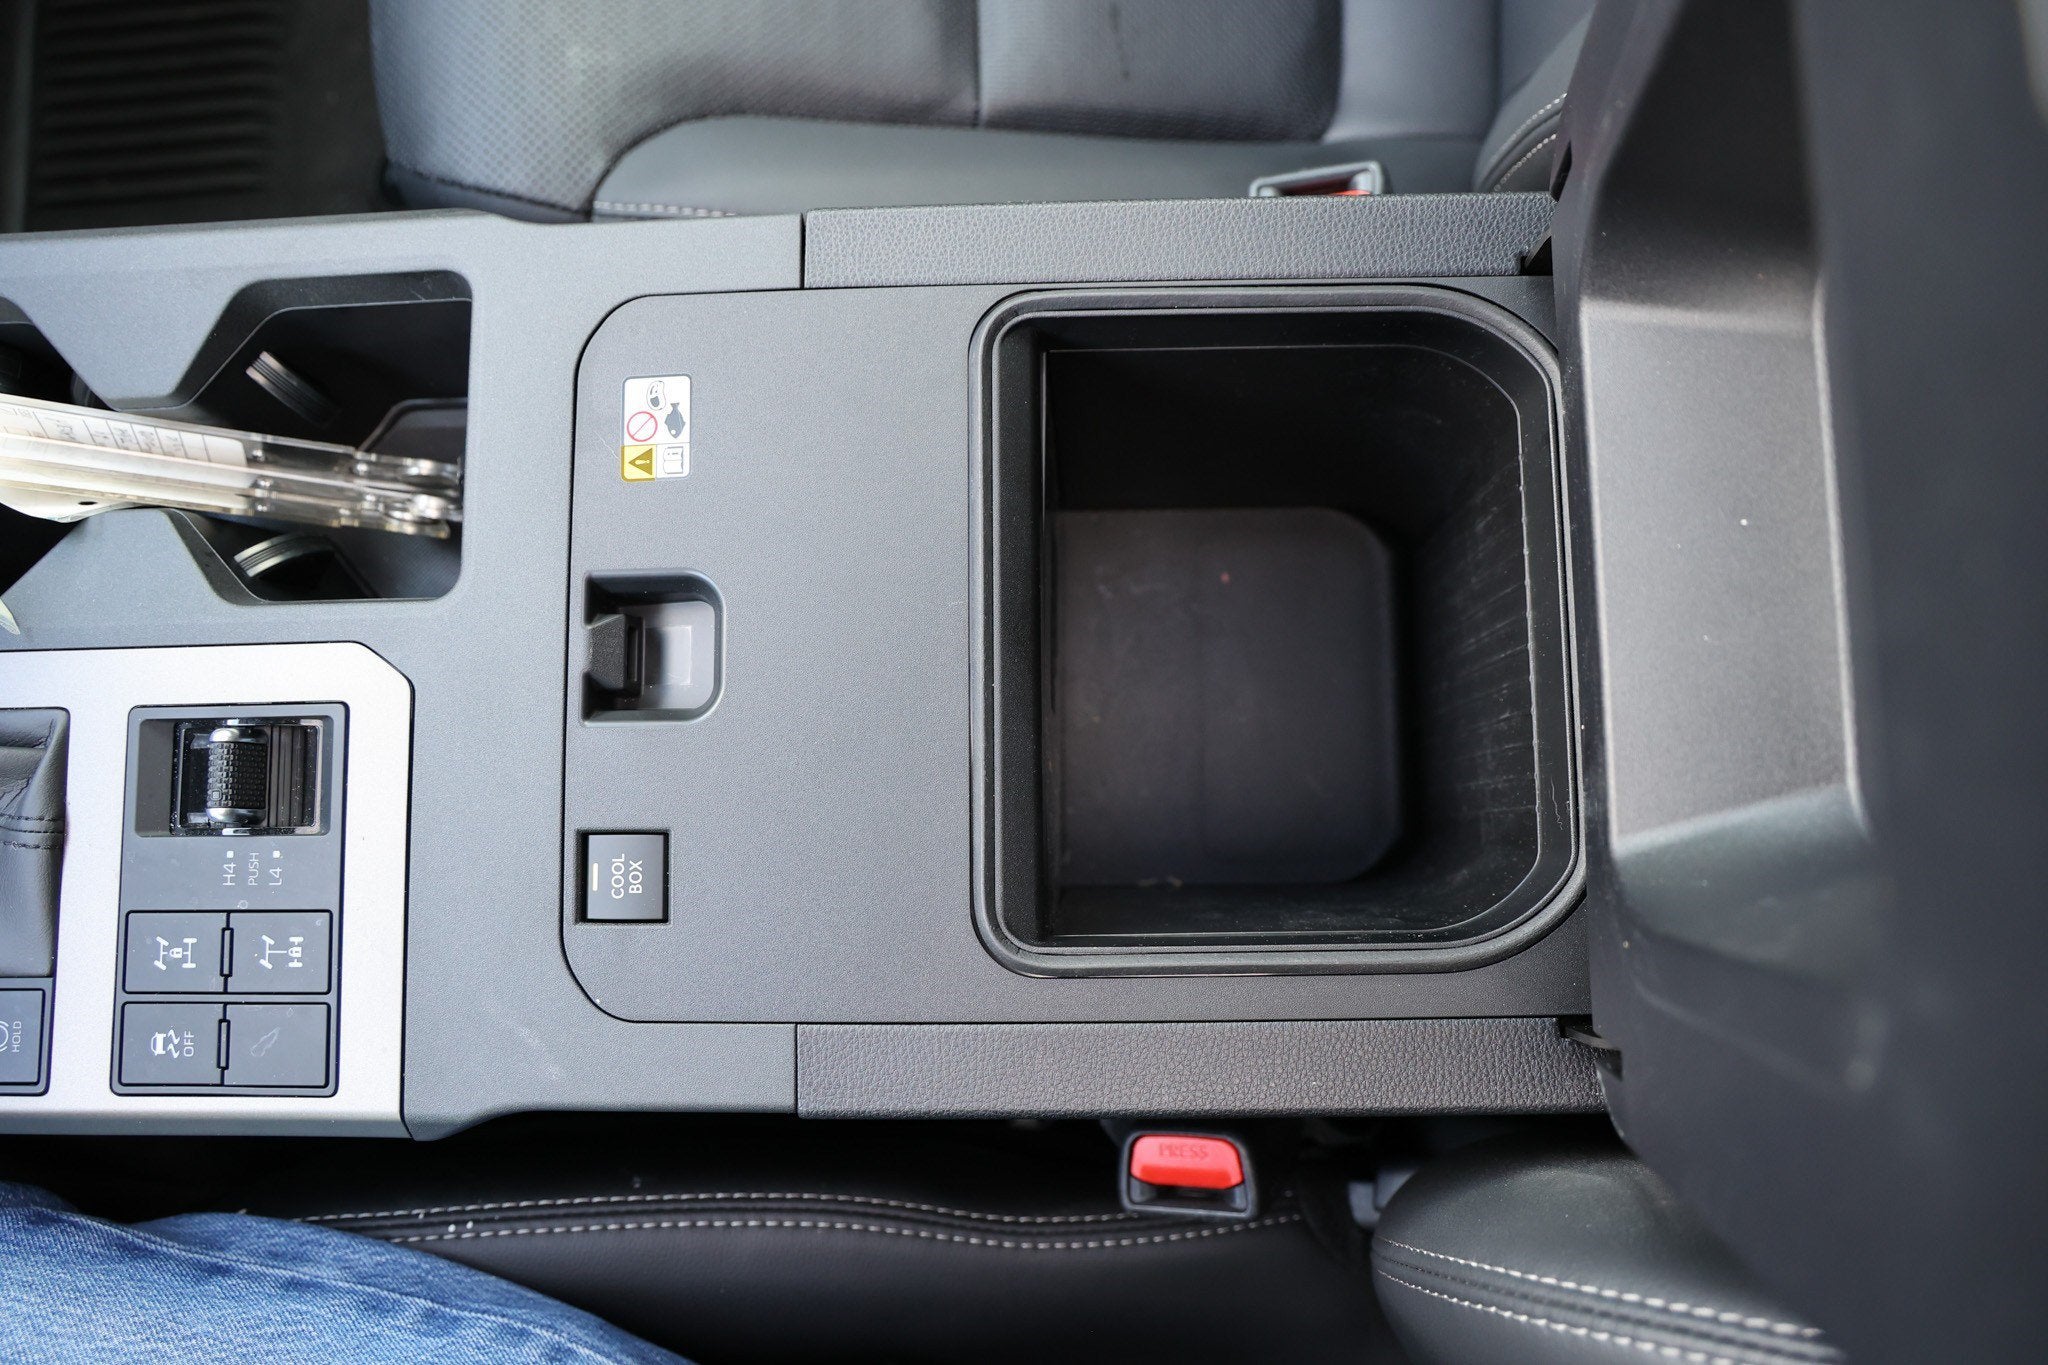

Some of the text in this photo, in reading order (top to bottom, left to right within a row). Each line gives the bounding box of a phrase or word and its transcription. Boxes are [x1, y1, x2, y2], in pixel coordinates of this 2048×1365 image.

[222, 862, 236, 886] H4
[248, 852, 260, 886] PUSH
[269, 867, 282, 886] L4
[611, 853, 625, 900] COOL
[628, 860, 643, 894] BOX
[12, 1020, 22, 1053] HOLD
[183, 1030, 195, 1057] OFF
[1159, 1143, 1210, 1160] PRESS
